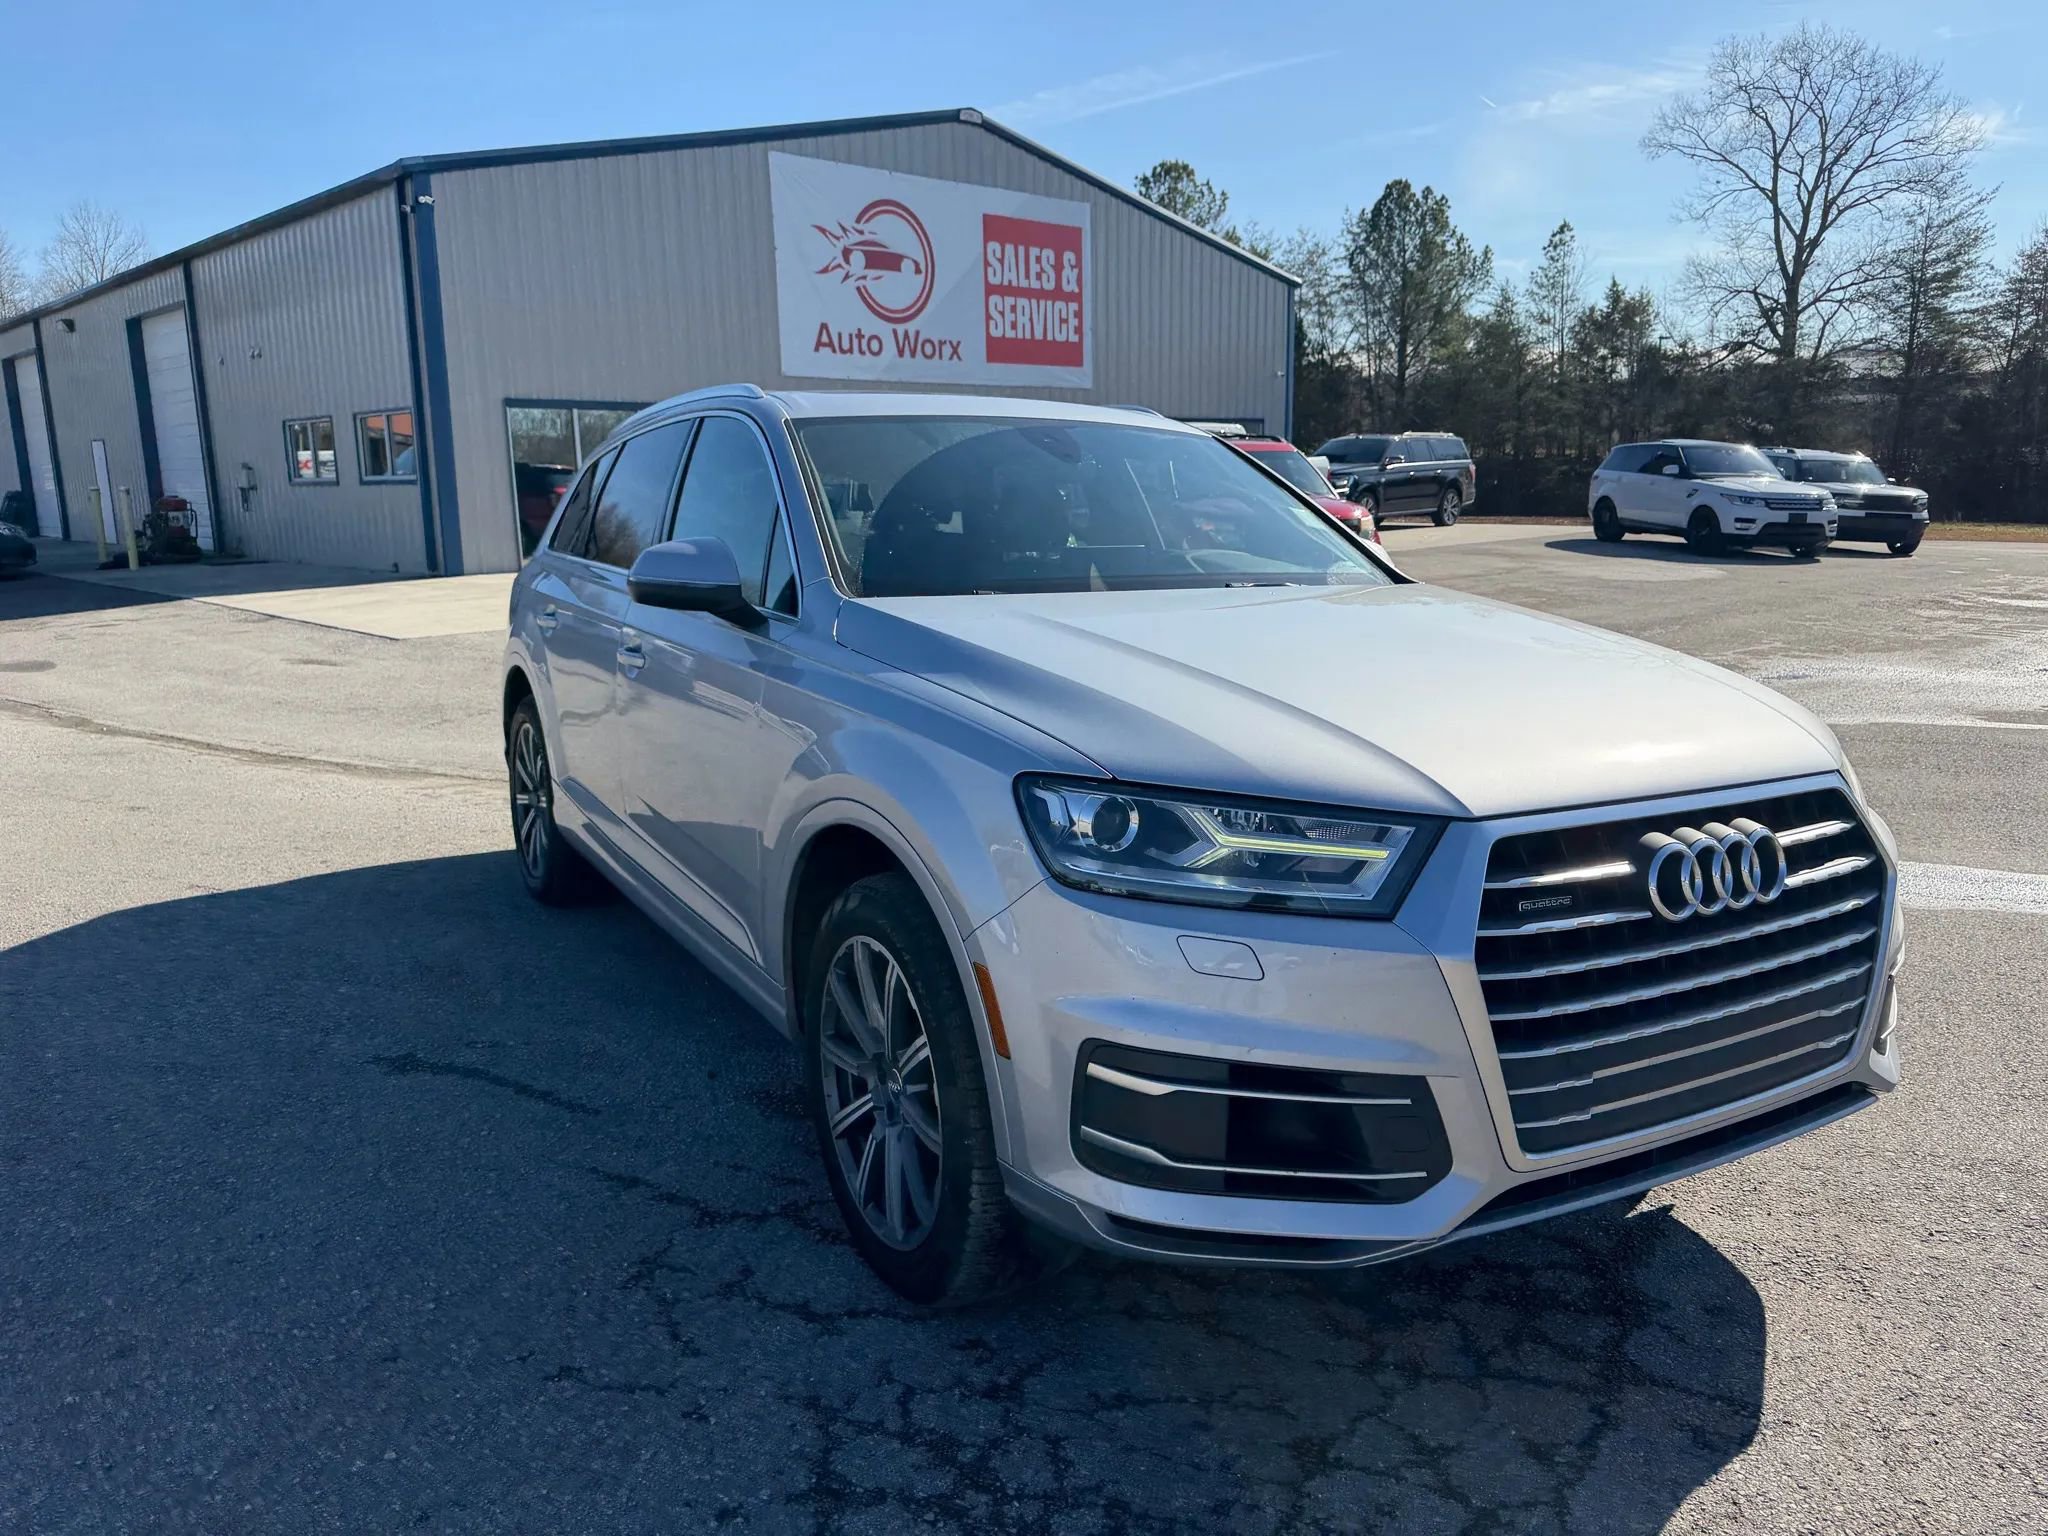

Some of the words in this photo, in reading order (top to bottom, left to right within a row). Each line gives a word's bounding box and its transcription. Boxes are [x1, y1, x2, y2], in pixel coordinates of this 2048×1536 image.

[987, 241, 1056, 291] SALES
[1061, 250, 1079, 293] &
[989, 294, 1079, 343] SERVICE
[814, 322, 883, 356] Auto
[892, 328, 962, 361] Worx
[1521, 898, 1571, 910] quattro
